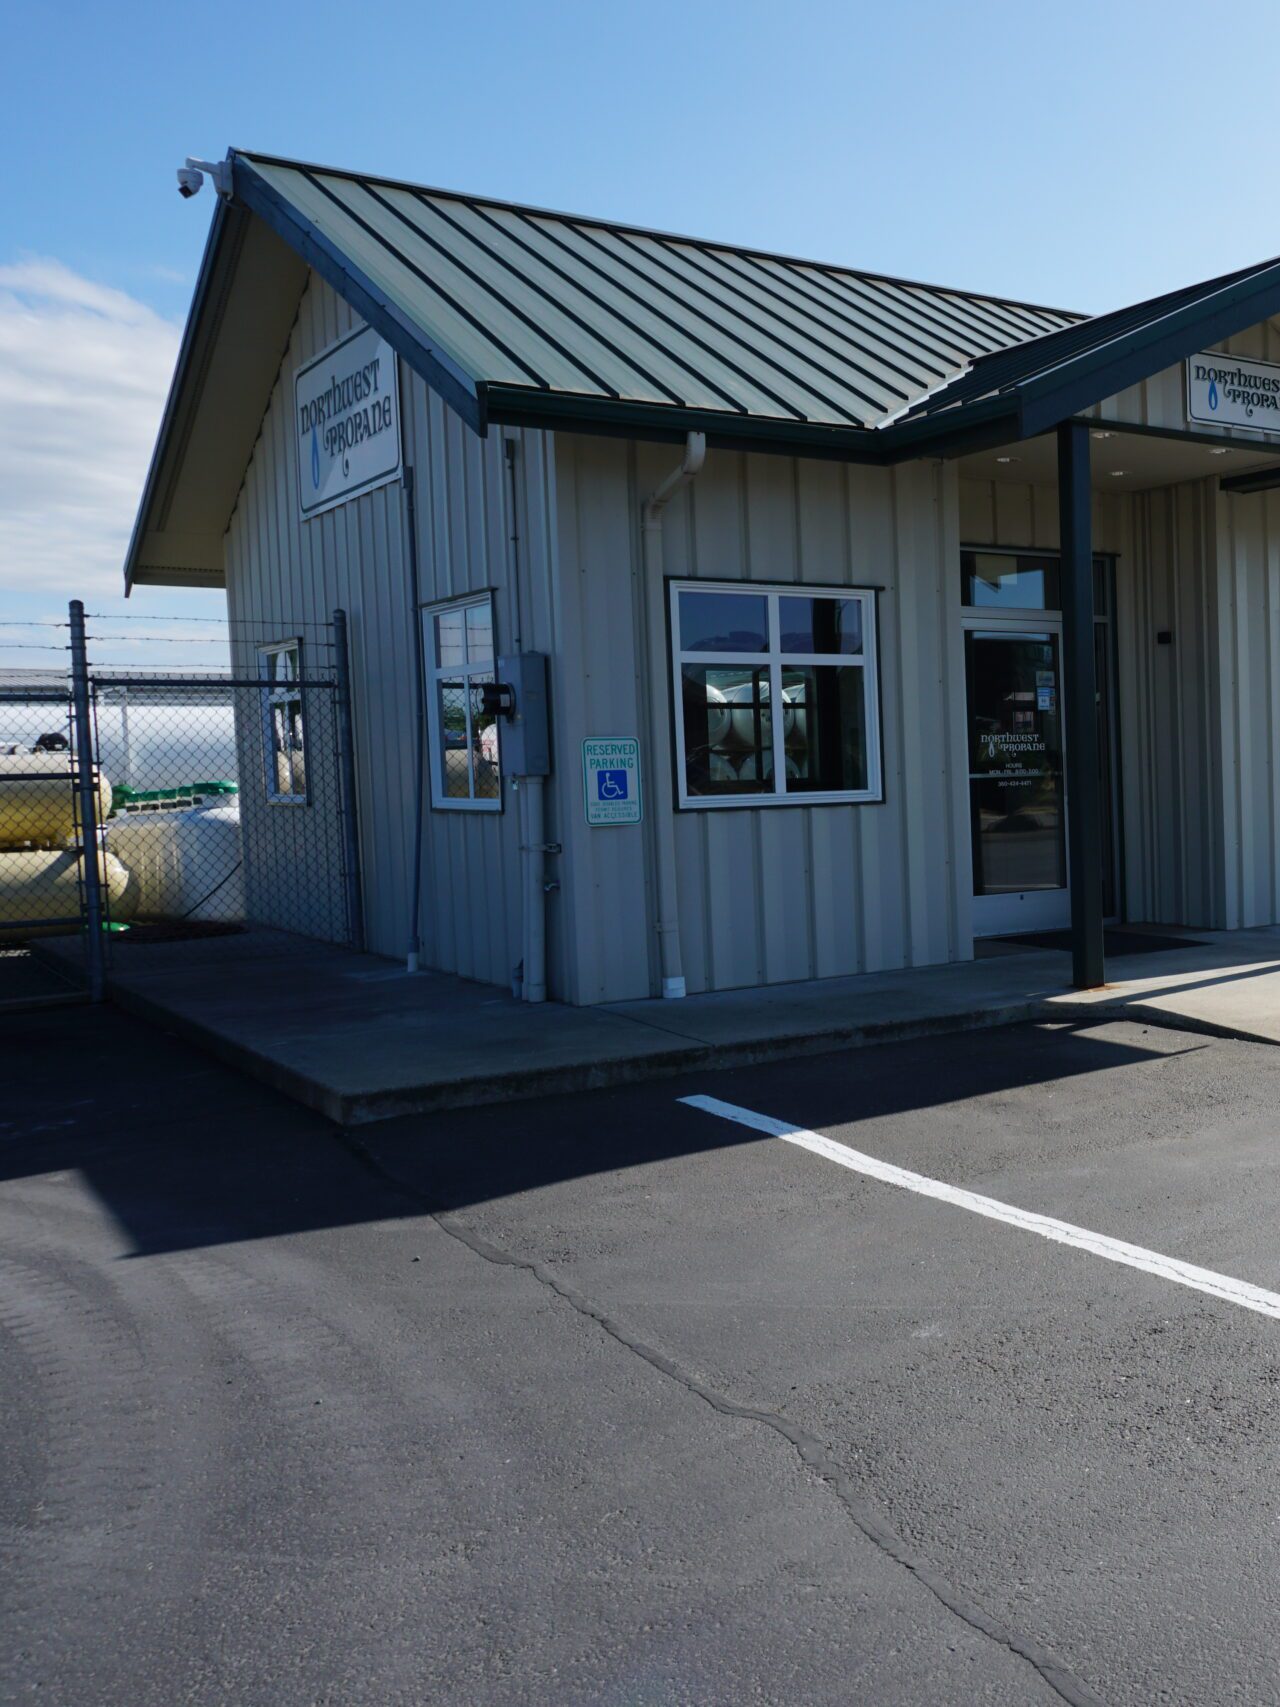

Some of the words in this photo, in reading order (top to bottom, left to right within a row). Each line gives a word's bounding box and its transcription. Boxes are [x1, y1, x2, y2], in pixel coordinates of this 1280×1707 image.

[325, 396, 392, 477] PROPANE
[586, 744, 635, 756] RESERVED
[1000, 743, 1046, 757] PROPANE
[590, 758, 634, 769] PARKING
